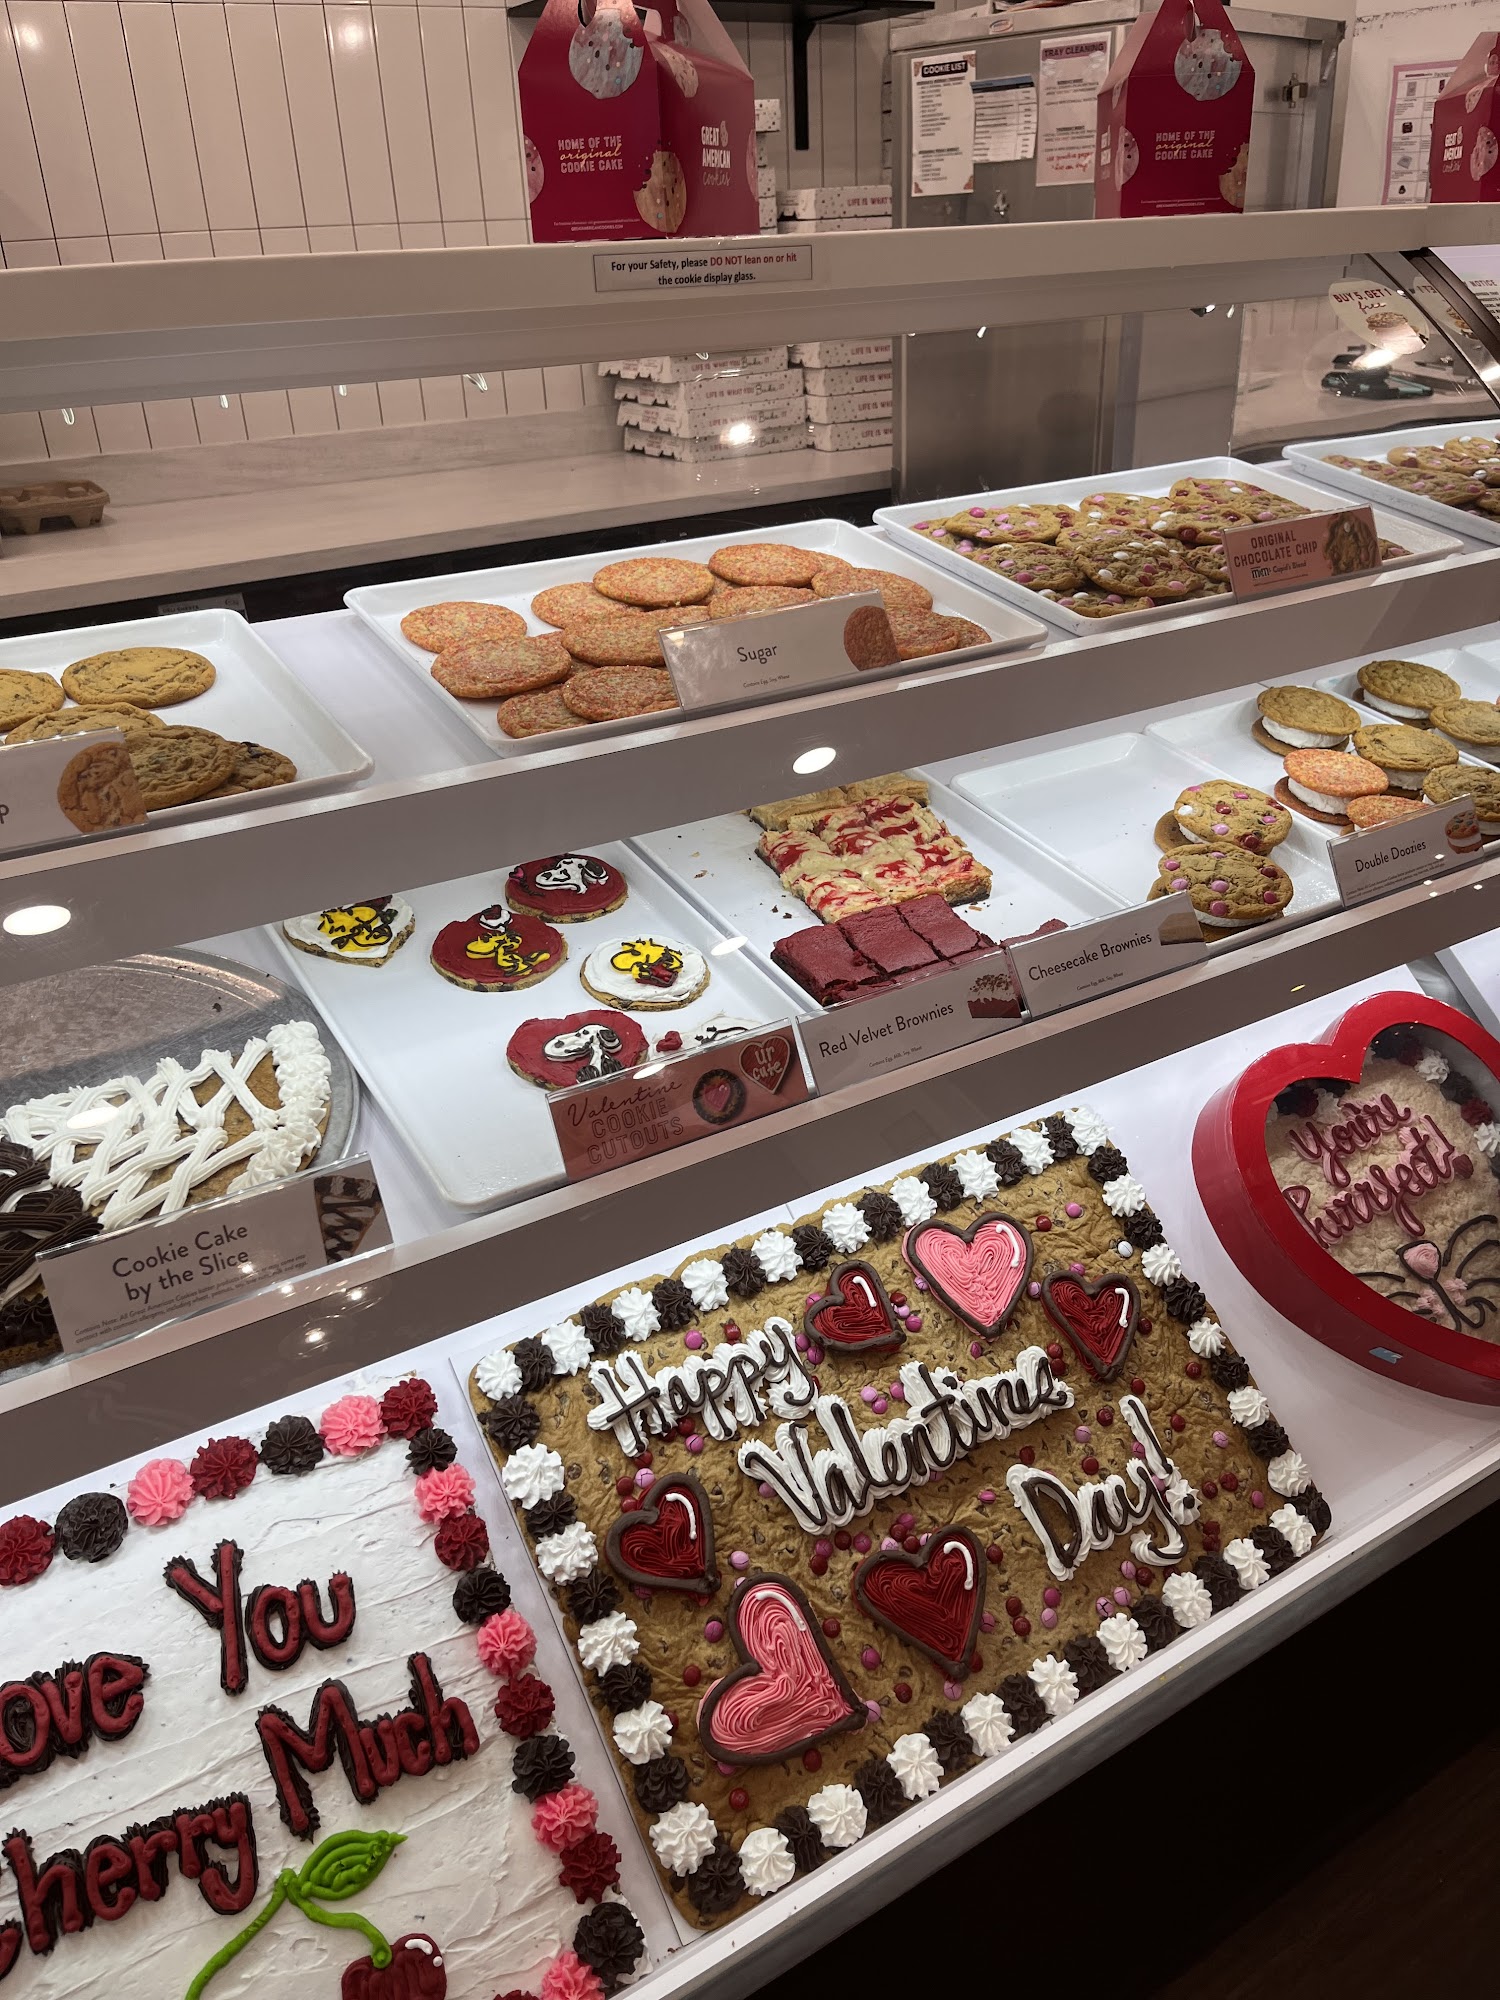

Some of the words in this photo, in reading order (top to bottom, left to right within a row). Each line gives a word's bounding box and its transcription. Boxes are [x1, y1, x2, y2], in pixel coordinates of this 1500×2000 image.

[1065, 43, 1104, 55] CLEANING
[923, 63, 950, 75] COOKIE
[951, 61, 966, 72] LIST
[558, 138, 585, 151] HOME
[588, 137, 601, 149] OF
[603, 135, 622, 148] THE
[701, 126, 720, 147] GREAT
[1155, 132, 1181, 142] HOME
[1184, 131, 1196, 140] OF
[1199, 130, 1215, 140] THE
[1155, 137, 1215, 156] original
[560, 143, 622, 168] original
[702, 148, 731, 169] AMERICAN
[1155, 150, 1187, 161] COOKIE
[1190, 149, 1213, 159] CAKE
[560, 161, 595, 174] COOKIE
[598, 159, 624, 171] CAKE
[847, 198, 861, 206] LIFE
[611, 261, 626, 271] For
[628, 262, 648, 273] your
[649, 259, 679, 271] Safety,
[681, 257, 708, 270] please
[710, 257, 723, 267] DO
[725, 255, 742, 265] NOT
[744, 254, 762, 264] lean
[763, 255, 774, 264] on
[776, 255, 785, 263] or
[786, 252, 797, 262] hit
[658, 275, 673, 285] the
[674, 273, 702, 284] cookie
[703, 273, 732, 285] display
[734, 272, 756, 284] glass.
[1333, 292, 1355, 303] BUY
[1364, 289, 1385, 299] GET
[1384, 288, 1392, 296] 1
[1358, 301, 1387, 314] free
[851, 347, 864, 356] LIFE
[865, 346, 871, 354] IS
[874, 345, 890, 353] WHAT
[855, 375, 868, 383] LIFE
[858, 403, 870, 411] LIFE
[861, 430, 874, 438] LIFE
[1250, 530, 1296, 549] ORIGINAL
[1234, 546, 1292, 568] CHOCOLATE
[1295, 541, 1318, 556] CHIP
[737, 644, 778, 665] Sugar
[1355, 853, 1389, 872] Double
[1390, 841, 1426, 860] Doozies
[1028, 950, 1099, 981] Cheesecake
[1100, 933, 1152, 958] Brownies
[818, 1035, 848, 1058] Red
[849, 1023, 894, 1046] Velvet
[896, 1004, 954, 1032] Brownies
[752, 1061, 784, 1081] cute
[567, 1080, 683, 1127] Valentine
[591, 1097, 669, 1139] COOKIE
[586, 1117, 684, 1165] CUTOUTS
[112, 1242, 189, 1278] Cookie
[194, 1224, 249, 1250] Cake
[124, 1282, 152, 1304] by
[158, 1267, 195, 1290] the
[198, 1249, 249, 1277] Slice
[120, 1313, 129, 1321] All
[129, 1308, 146, 1318] Great
[147, 1298, 175, 1311] American
[175, 1291, 198, 1301] Cookies
[76, 1331, 98, 1343] contact
[100, 1326, 113, 1335] with
[113, 1319, 138, 1331] common
[588, 1317, 818, 1456] Happy
[1007, 1396, 1201, 1578] Day!
[0, 1651, 151, 1780] ove
[163, 1538, 357, 1696] You
[0, 1792, 260, 1975] herry
[255, 1651, 481, 1845] Much
